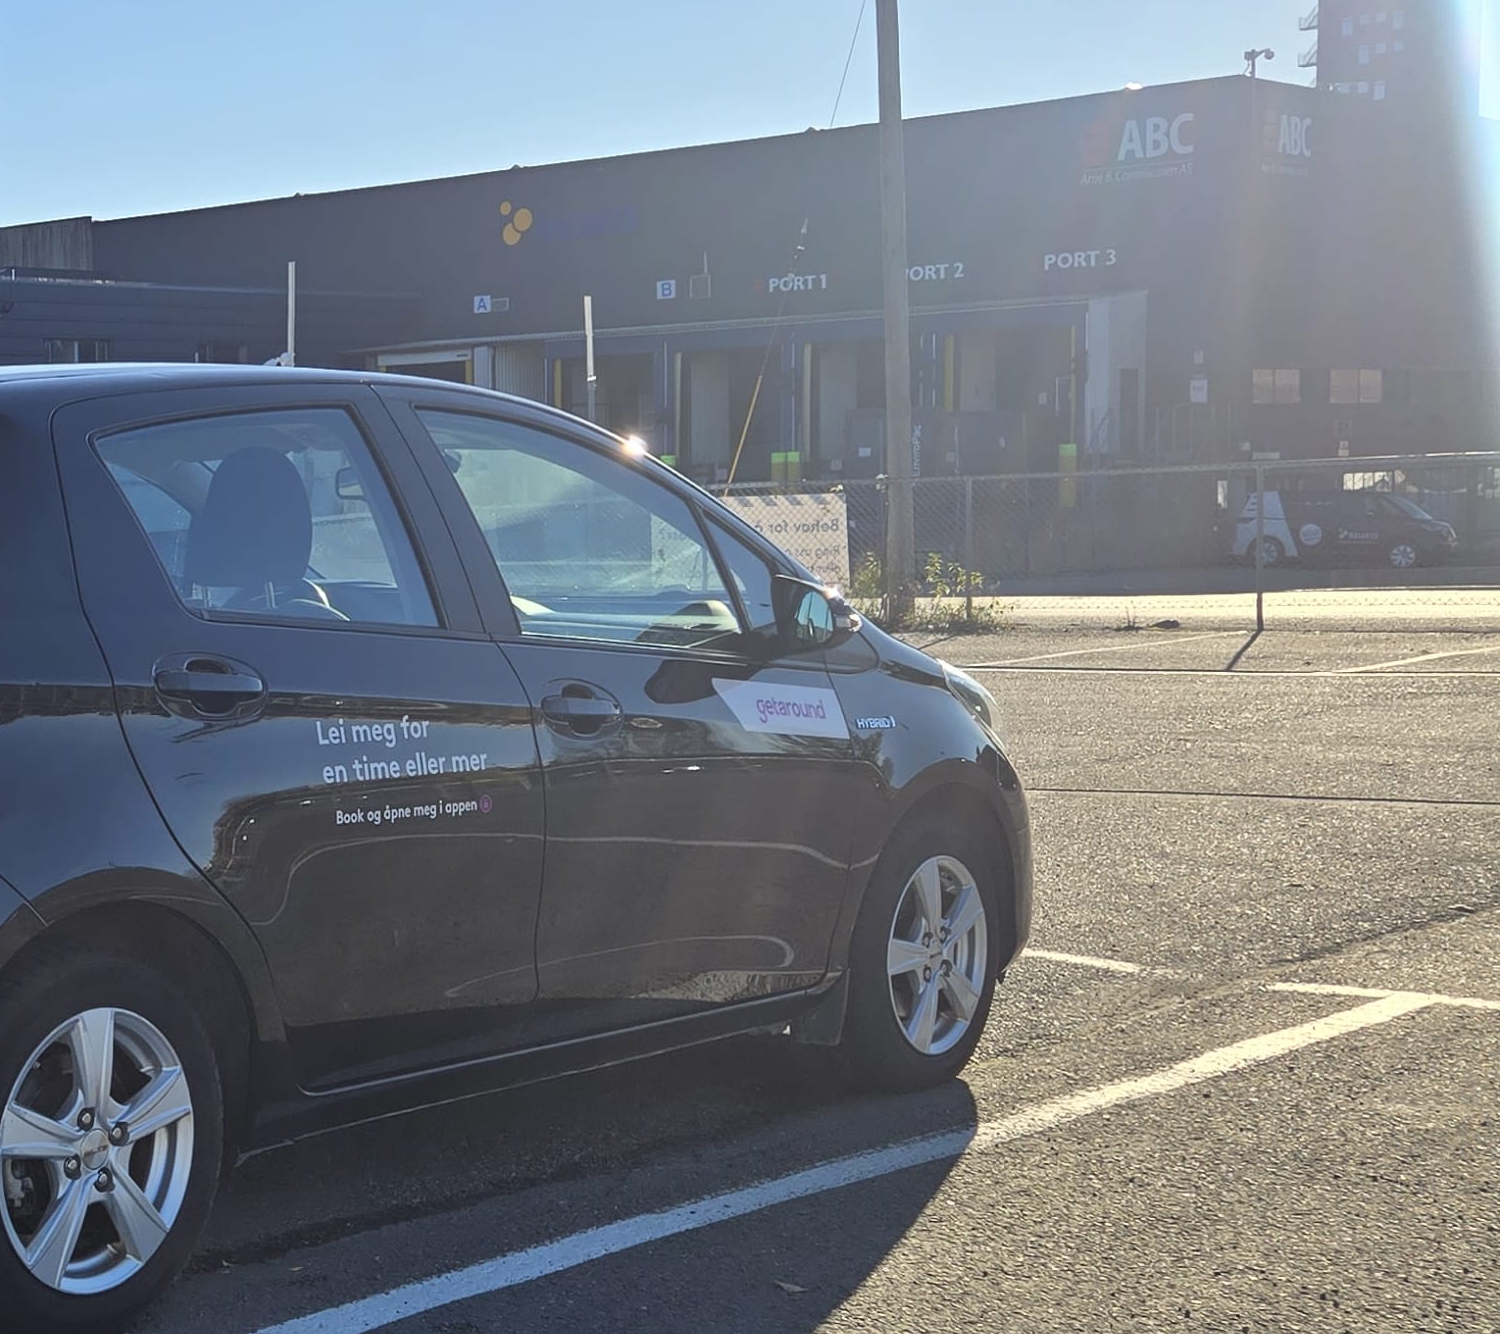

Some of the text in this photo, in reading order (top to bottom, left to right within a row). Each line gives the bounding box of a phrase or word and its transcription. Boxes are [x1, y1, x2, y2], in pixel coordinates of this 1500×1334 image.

[1116, 112, 1195, 161] ABC
[1276, 114, 1312, 157] ABC
[905, 262, 964, 281] ORT 2
[1043, 249, 1117, 271] PORT 3
[661, 283, 673, 298] B
[768, 273, 828, 294] PORT 1
[477, 297, 488, 312] A
[756, 698, 826, 724] getaround
[856, 717, 890, 729] HYBRID
[315, 714, 430, 749] Lei meg for
[322, 751, 488, 785] en time eller mer
[336, 807, 364, 825] Book
[367, 810, 382, 825] og
[384, 803, 411, 823] åpne
[413, 805, 438, 820] meg
[445, 799, 478, 817] appen
